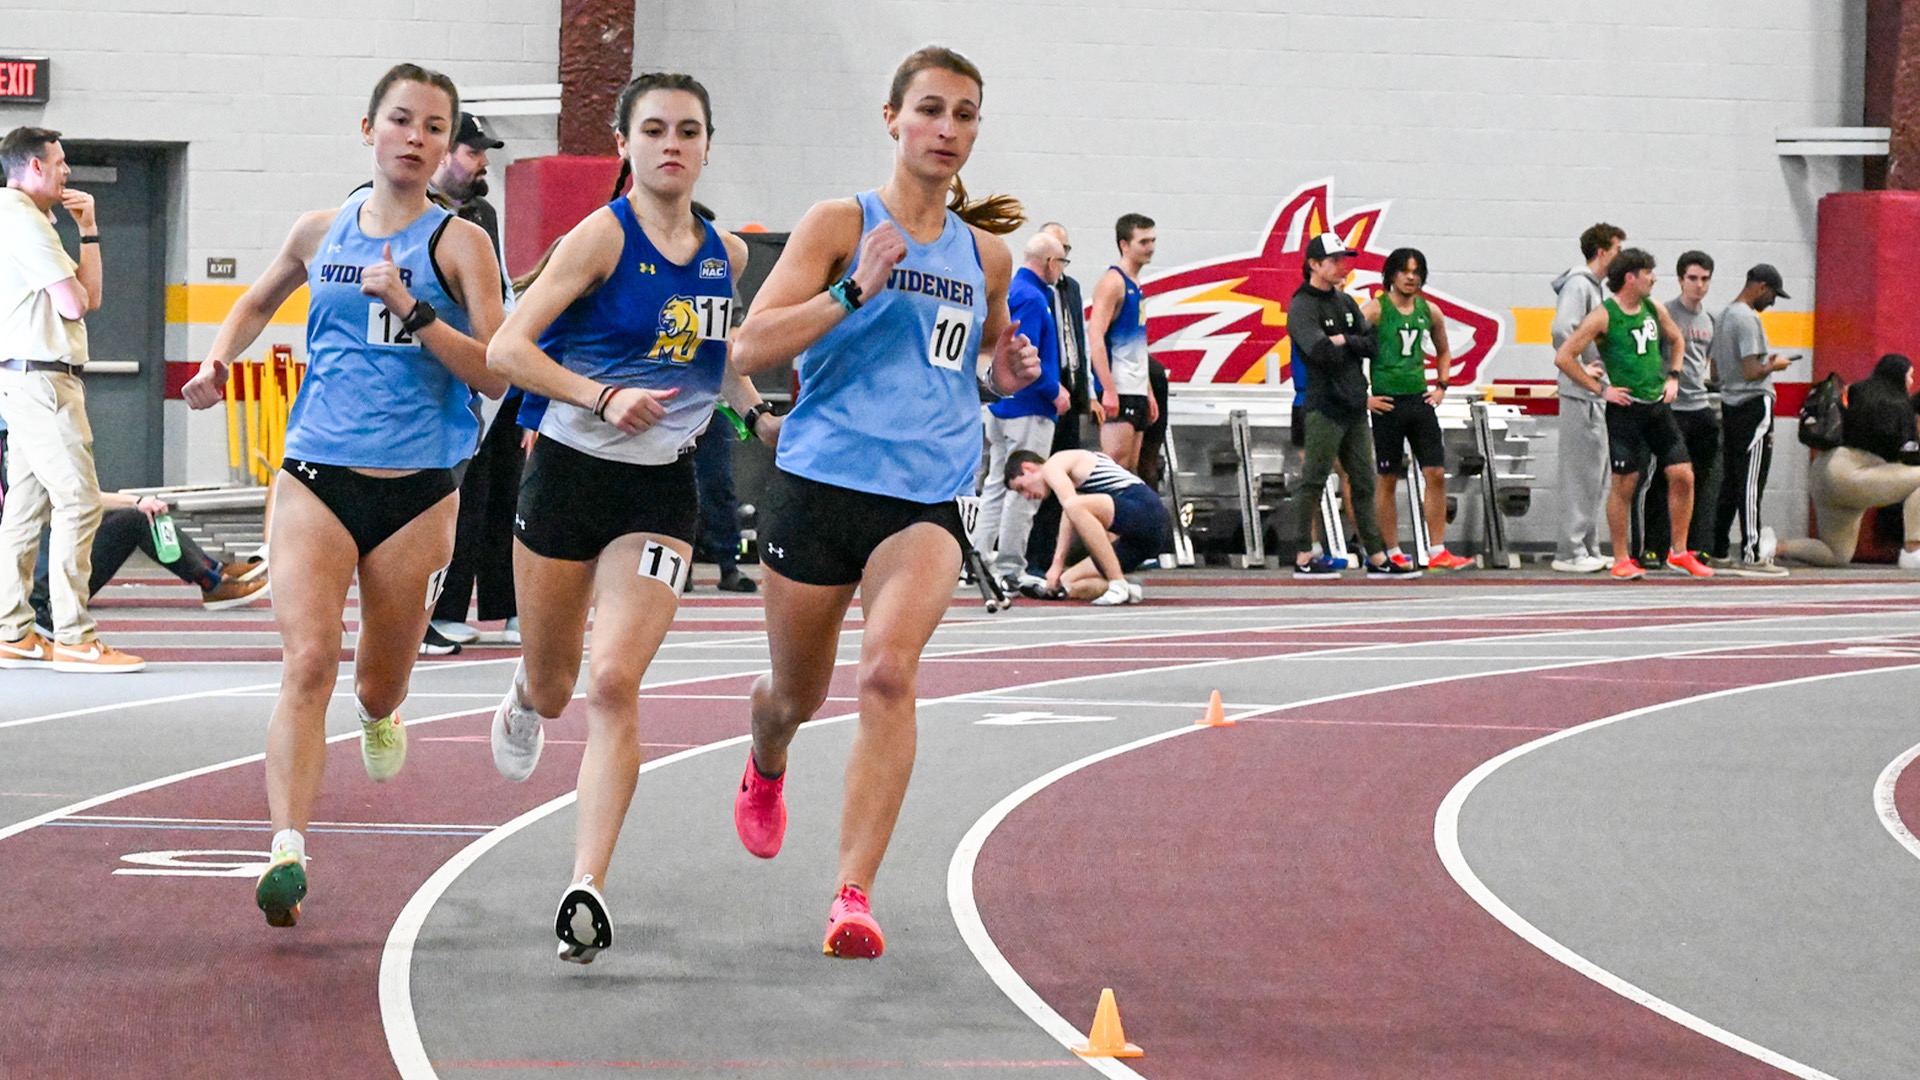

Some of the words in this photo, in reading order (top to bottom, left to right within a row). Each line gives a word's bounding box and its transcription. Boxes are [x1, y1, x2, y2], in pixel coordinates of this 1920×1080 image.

[0, 62, 37, 96] EXIT
[210, 263, 233, 273] EXIT
[320, 264, 412, 288] WIDR
[701, 298, 729, 339] 11
[934, 319, 966, 361] 10
[1399, 329, 1418, 356] Y
[1631, 327, 1650, 355] Y
[648, 545, 682, 588] 11
